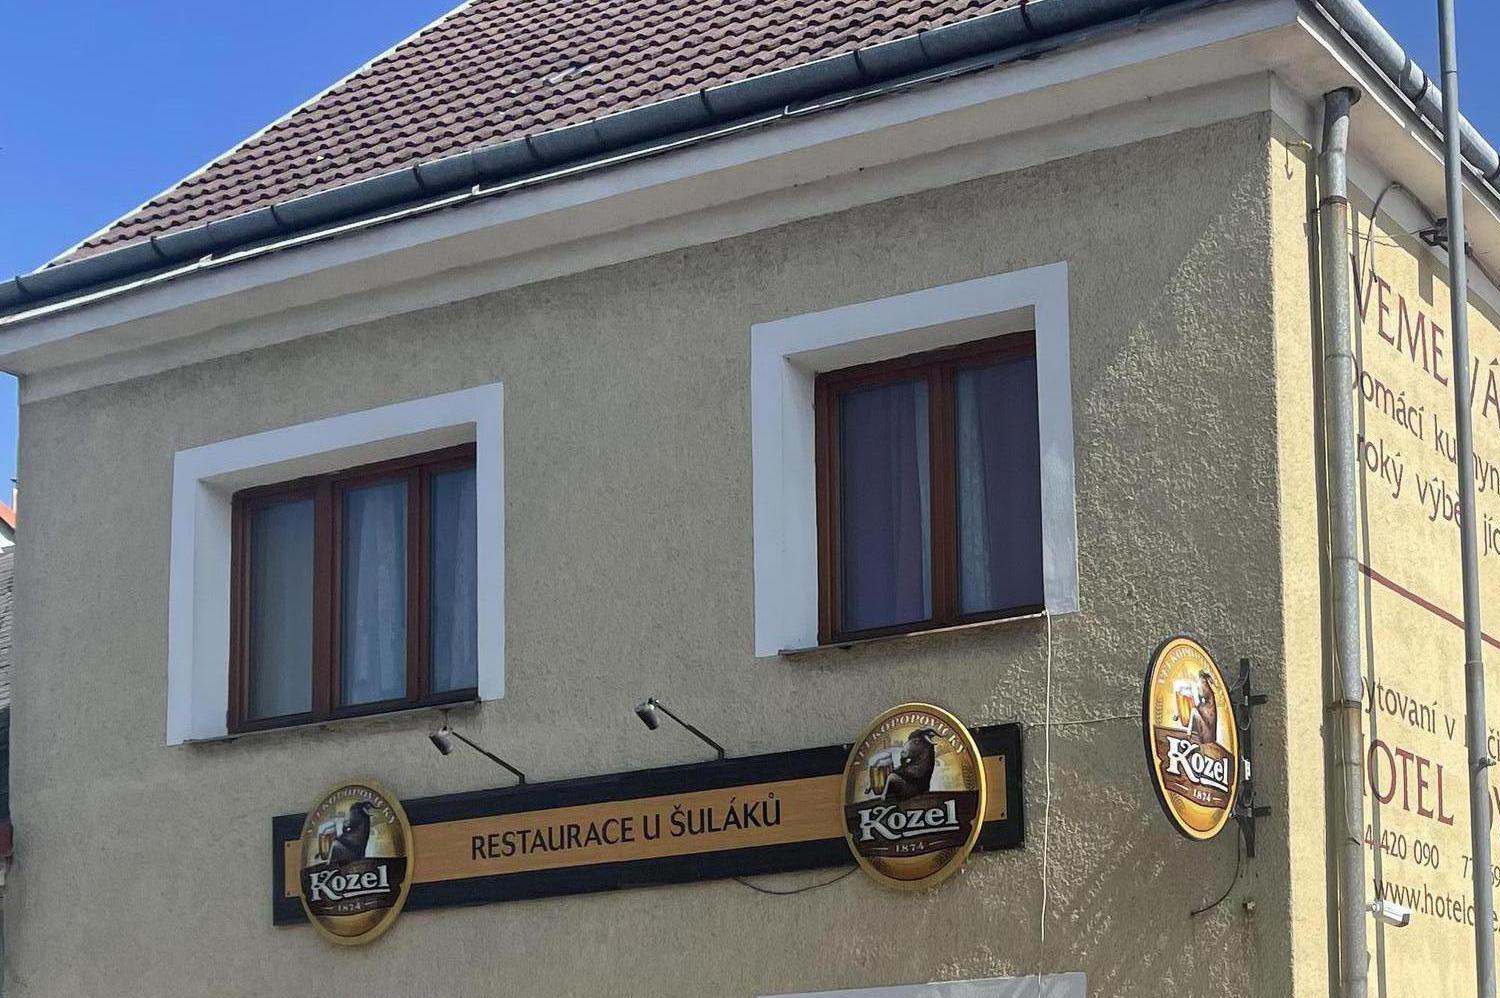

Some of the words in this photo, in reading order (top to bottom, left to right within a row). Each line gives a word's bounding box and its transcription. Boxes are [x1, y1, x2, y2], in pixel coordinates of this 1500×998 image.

[1350, 253, 1448, 386] VEME
[1357, 433, 1404, 499] roký
[1416, 473, 1462, 528] výbě
[1363, 676, 1436, 734] ytovaní
[1444, 714, 1456, 741] v
[1166, 736, 1229, 792] Kozel
[1362, 733, 1455, 826] OTEL
[1193, 788, 1212, 802] 1874
[471, 817, 635, 860] RESTAURACE
[643, 813, 660, 840] U
[670, 792, 781, 838] ŠULÁKŮ
[858, 799, 960, 841] Kozel
[895, 842, 925, 853] 1874
[1380, 829, 1407, 861] 420
[1413, 839, 1440, 870] 090
[309, 864, 391, 901] Kozel
[336, 901, 361, 912] 1874
